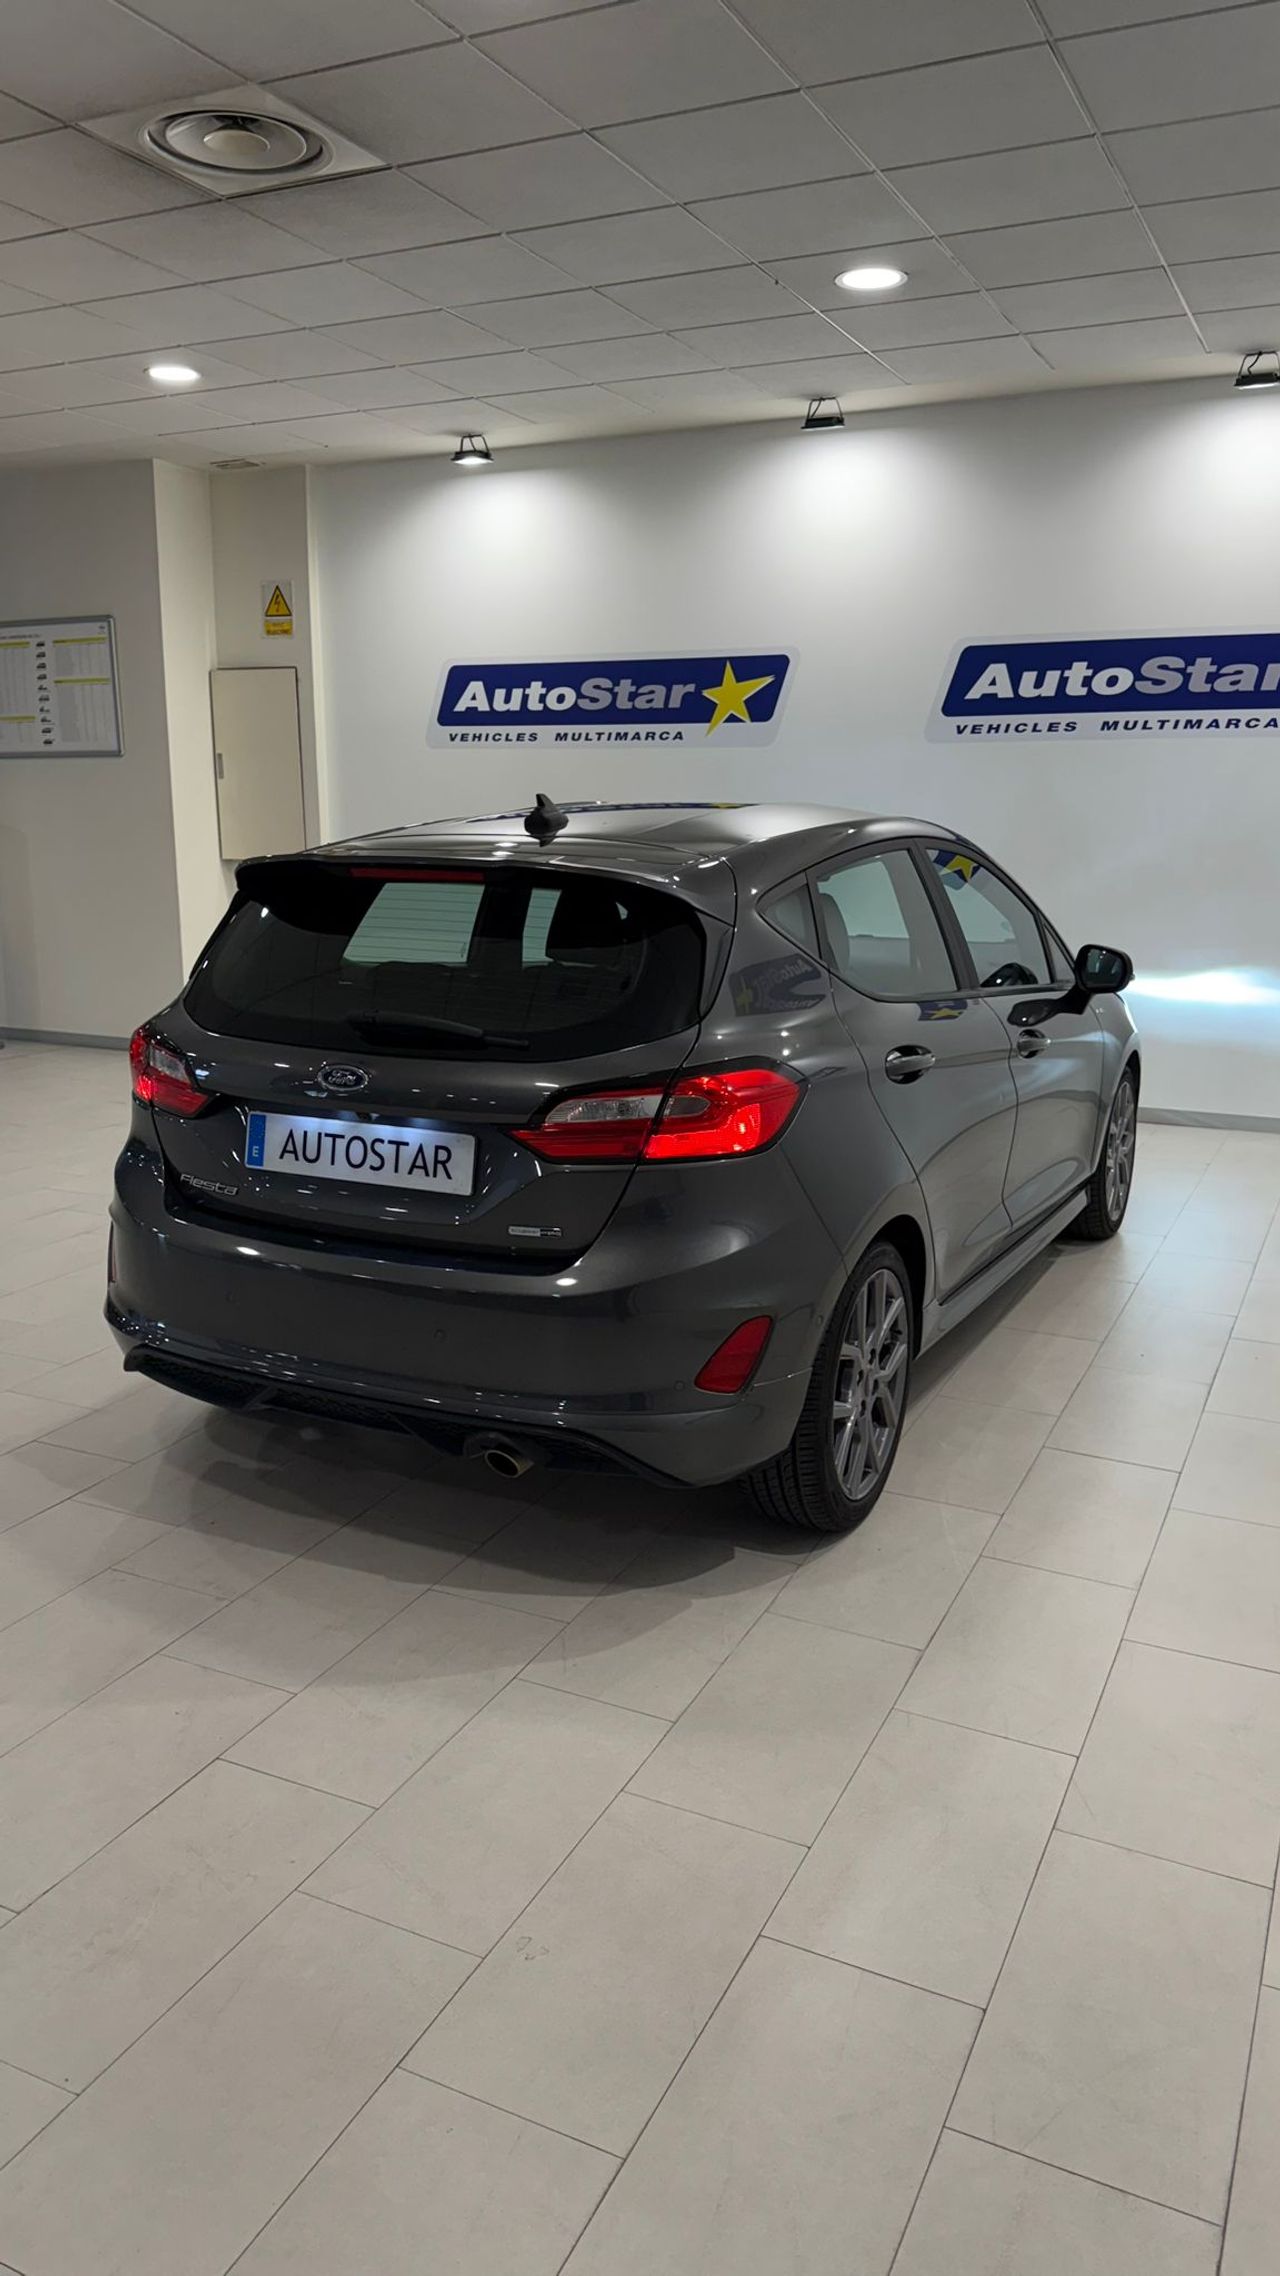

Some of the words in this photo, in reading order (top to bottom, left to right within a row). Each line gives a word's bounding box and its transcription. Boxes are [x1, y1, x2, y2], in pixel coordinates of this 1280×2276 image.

[452, 677, 695, 712] AutoStar
[955, 720, 1079, 735] VEHICLES
[1099, 716, 1279, 732] MULTIMARCA
[448, 732, 538, 743] VEHICLES
[554, 730, 684, 743] MULTIMARCA
[252, 1146, 259, 1158] E
[278, 1127, 453, 1180] AUTOSTAR
[180, 1173, 239, 1196] Fiesta
